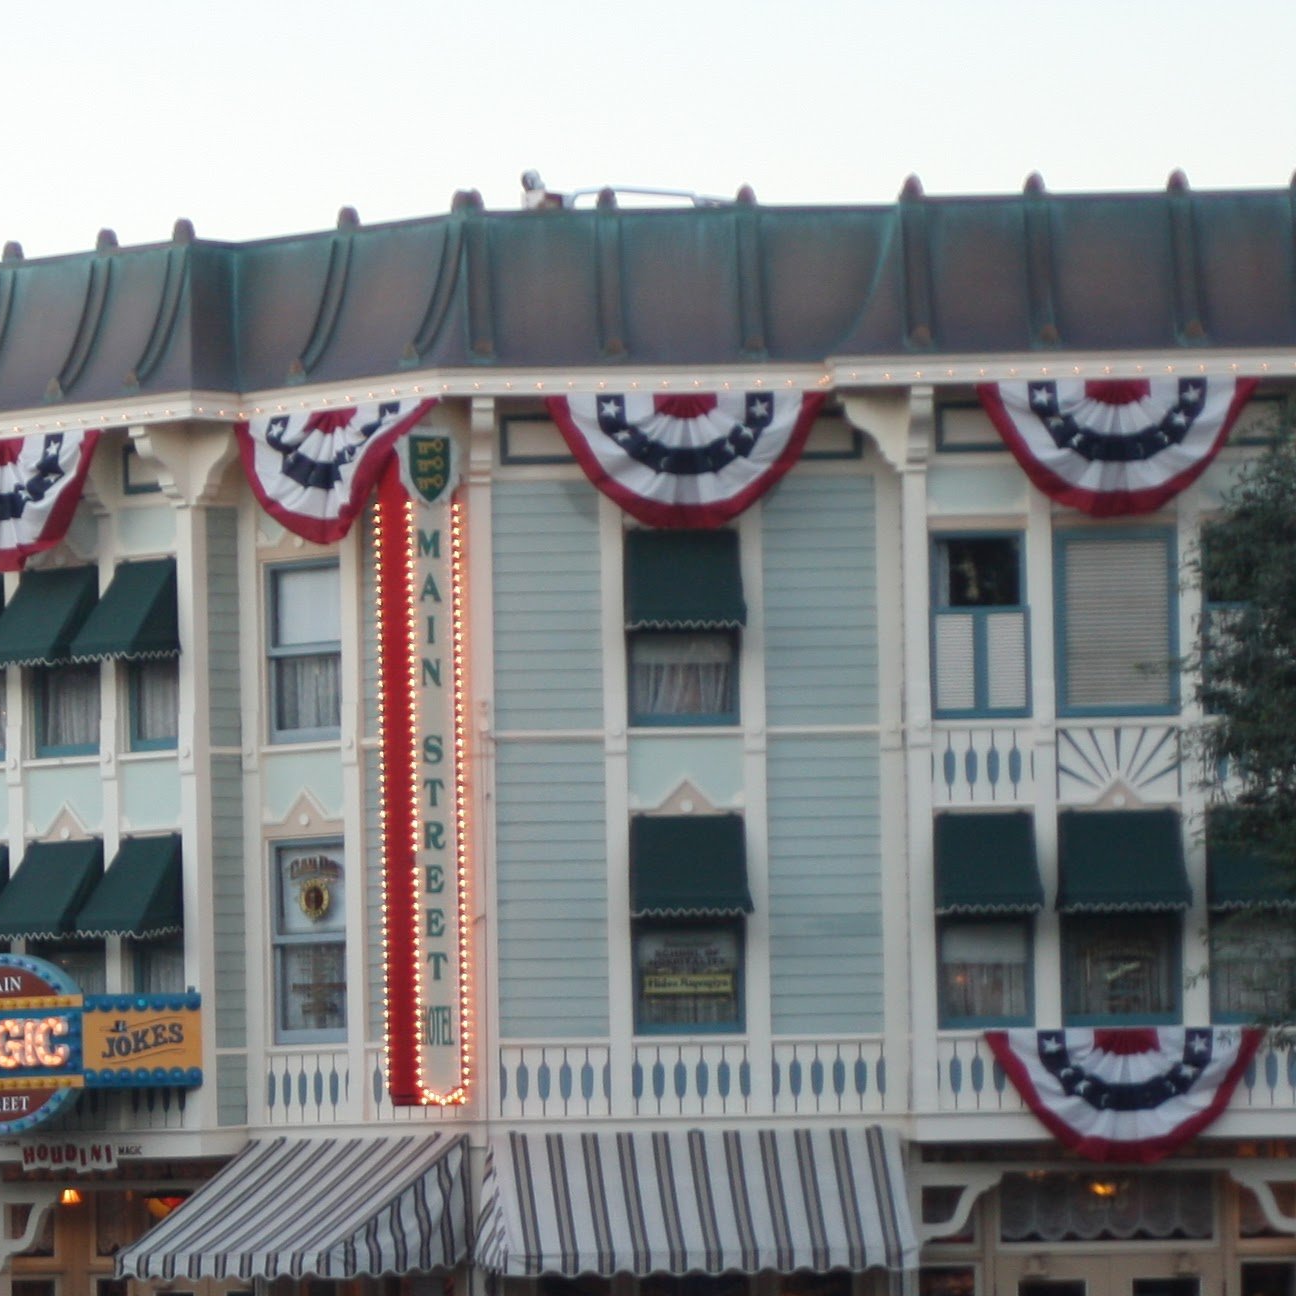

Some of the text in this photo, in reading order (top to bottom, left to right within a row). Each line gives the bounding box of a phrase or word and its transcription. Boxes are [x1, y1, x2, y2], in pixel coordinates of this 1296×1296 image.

[417, 528, 442, 687] MAIN
[422, 734, 449, 981] STREET
[101, 1019, 185, 1058] JOKES
[421, 1005, 455, 1046] HOTEL
[21, 1143, 112, 1167] HOUDINI
